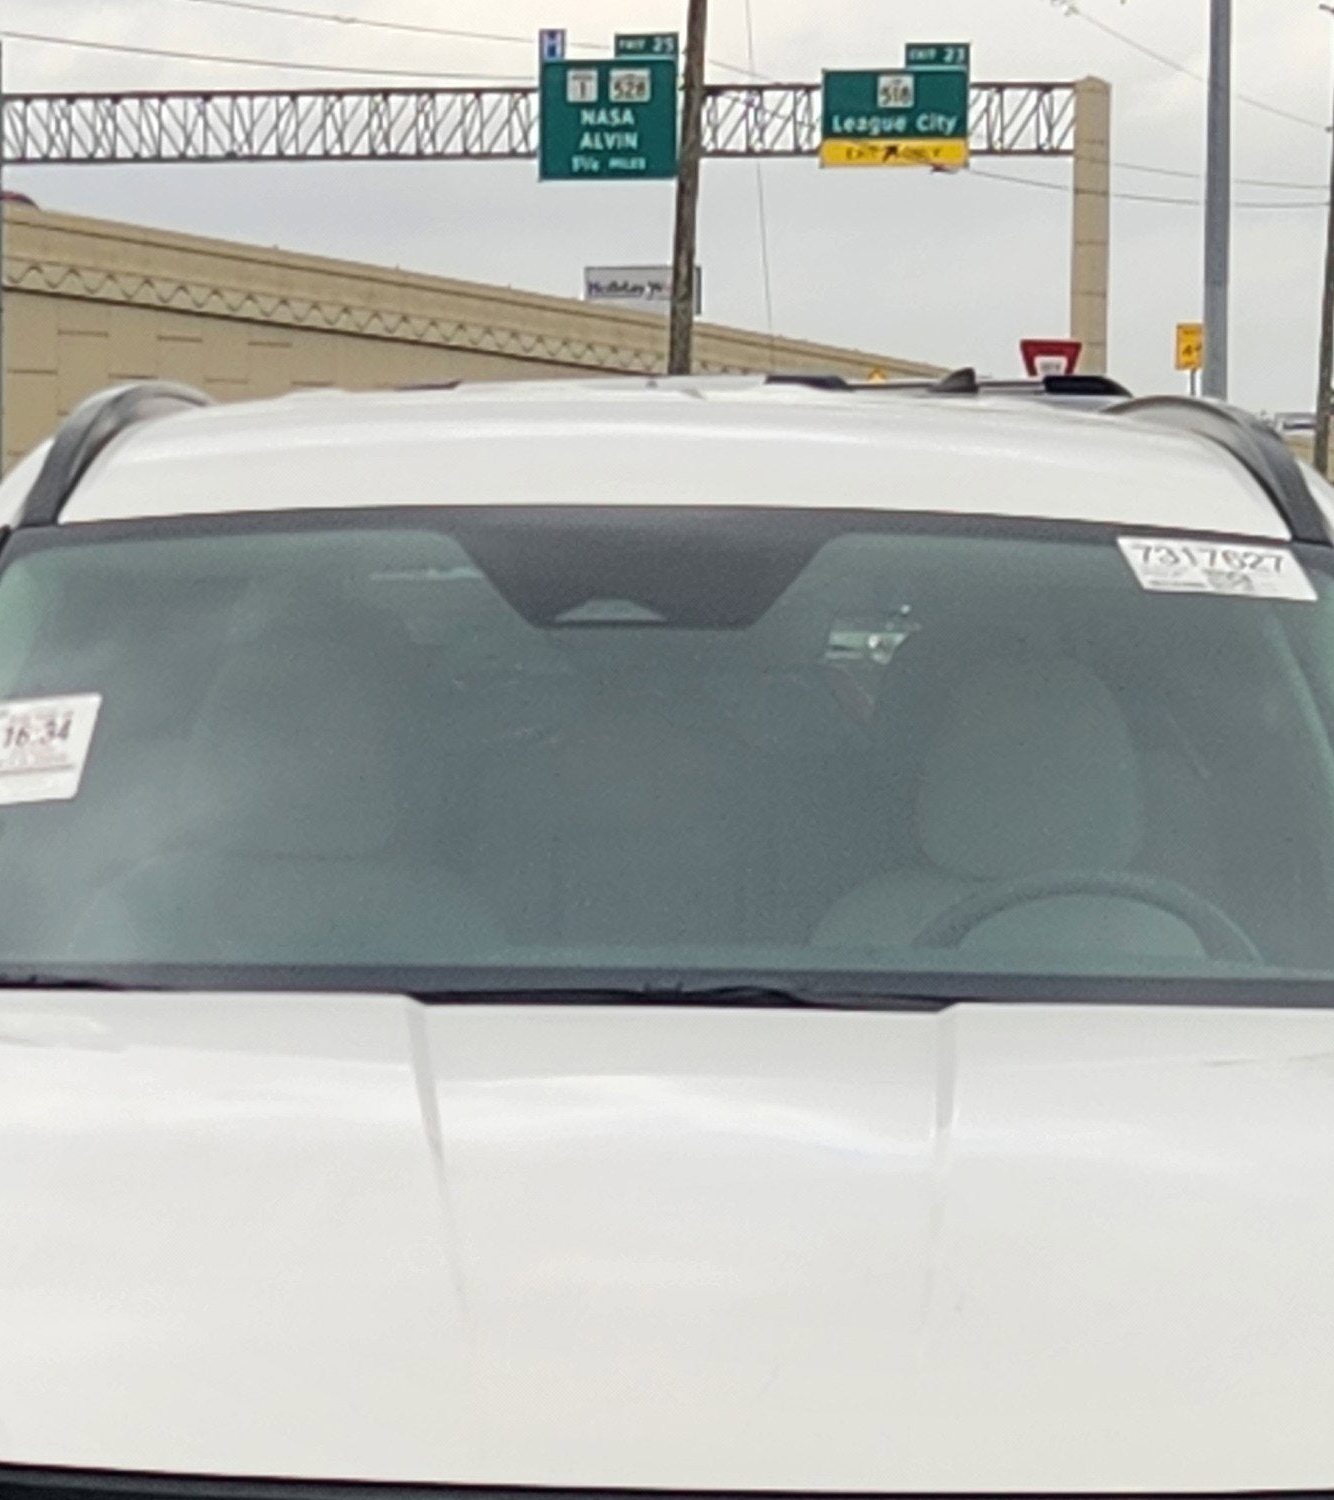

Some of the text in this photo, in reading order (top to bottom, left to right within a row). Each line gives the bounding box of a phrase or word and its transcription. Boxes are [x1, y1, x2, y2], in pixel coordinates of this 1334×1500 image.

[579, 107, 635, 127] NASA
[831, 112, 958, 136] League City
[578, 131, 639, 150] ALVIN
[607, 156, 647, 170] MILES
